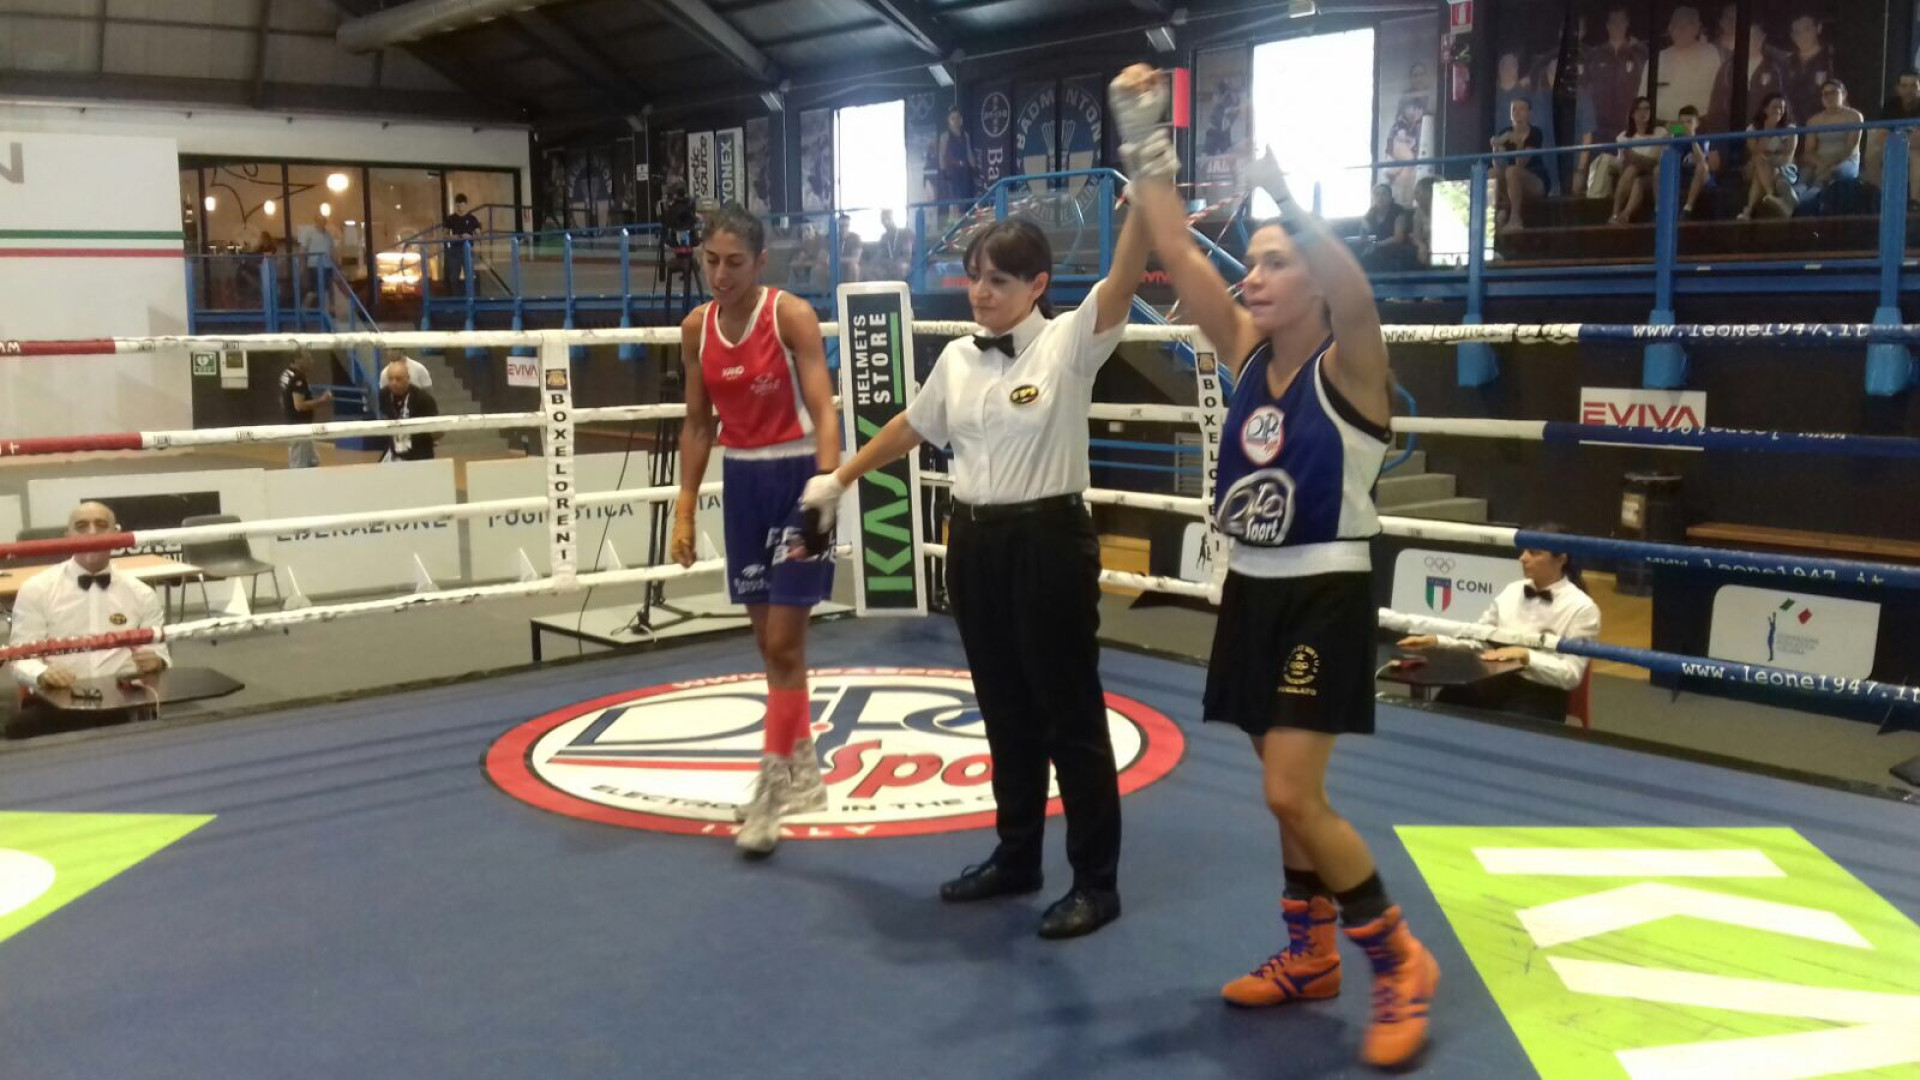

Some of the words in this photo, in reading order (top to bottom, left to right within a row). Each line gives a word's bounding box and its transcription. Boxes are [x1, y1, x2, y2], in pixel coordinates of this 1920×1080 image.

[1016, 88, 1102, 151] BADMNTON
[720, 141, 734, 204] YONEX
[987, 147, 1003, 180] Ba
[508, 364, 538, 376] EVIVA
[853, 313, 871, 405] HELMETS
[869, 311, 891, 404] STORE
[1583, 401, 1701, 428] EVIVA
[551, 393, 570, 561] BOXELORENI
[1456, 578, 1493, 594] CONI
[820, 738, 994, 799] Spo
